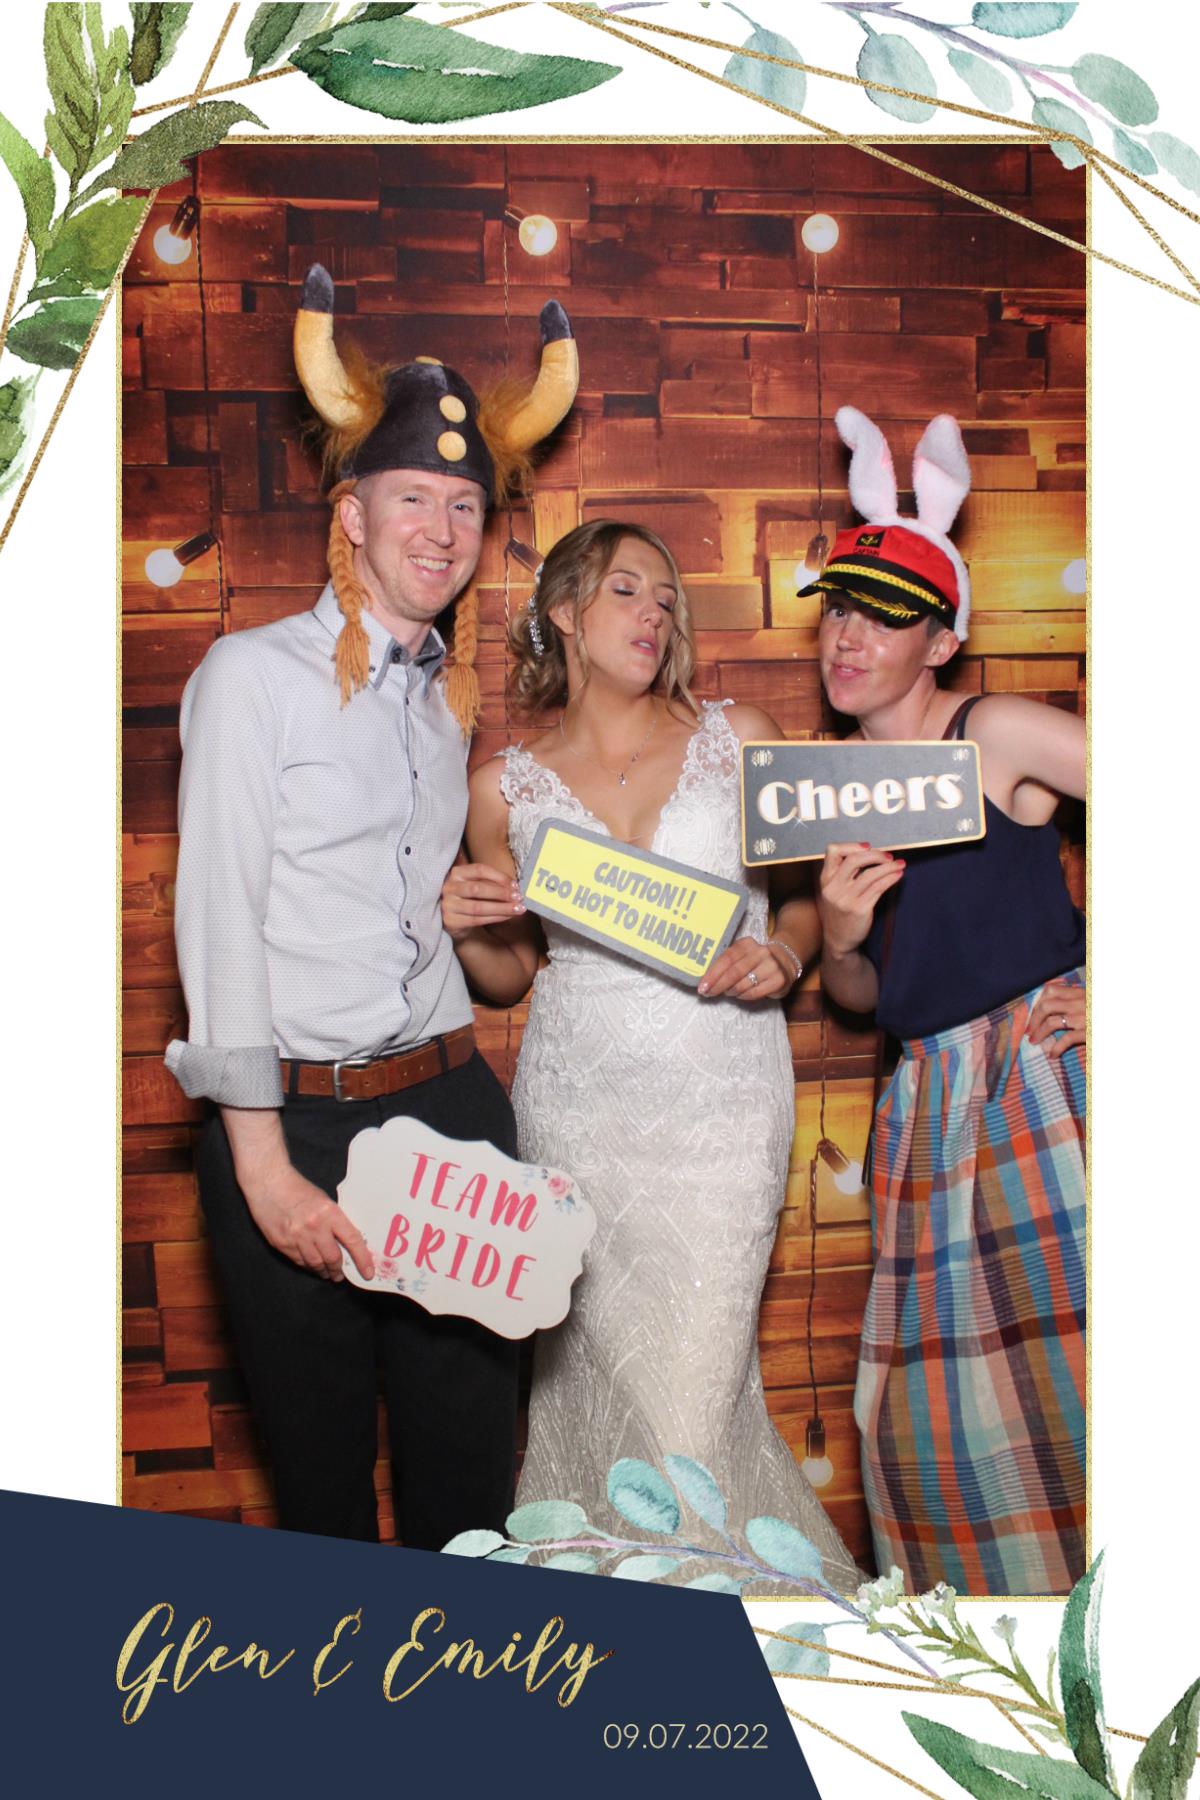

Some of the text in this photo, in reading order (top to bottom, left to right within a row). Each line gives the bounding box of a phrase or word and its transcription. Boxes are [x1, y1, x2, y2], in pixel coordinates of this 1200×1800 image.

[757, 773, 964, 825] Cheers
[535, 868, 715, 967] TOO HOT TO HANDLE
[594, 862, 697, 920] CAUTION!!
[409, 1152, 539, 1233] TEAM
[383, 1213, 537, 1302] BRIDE
